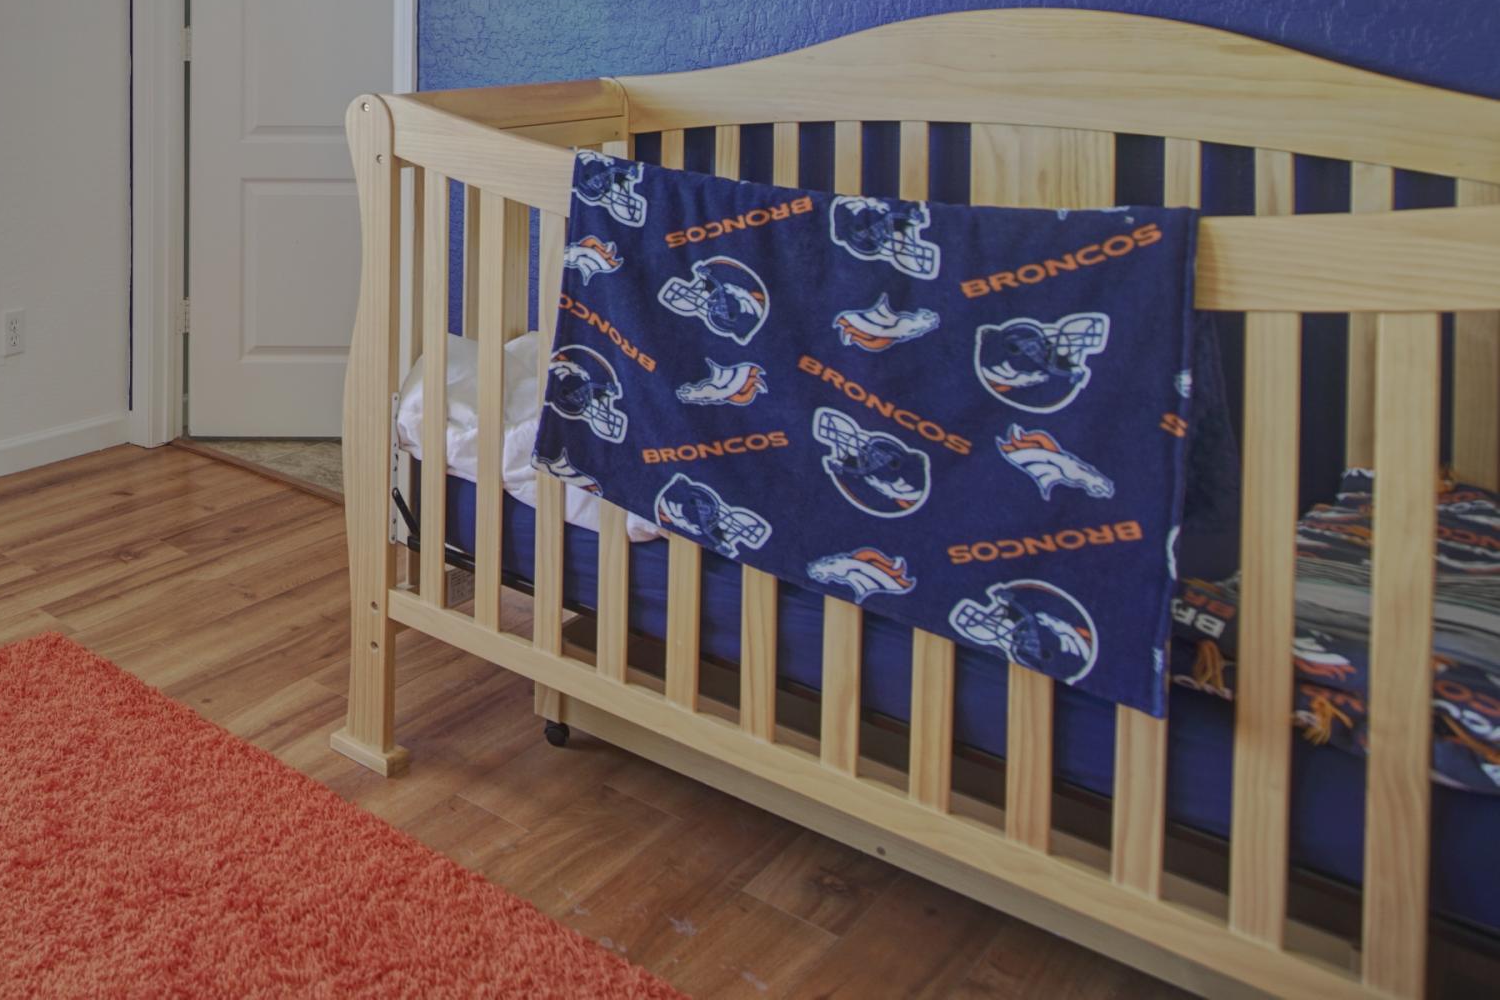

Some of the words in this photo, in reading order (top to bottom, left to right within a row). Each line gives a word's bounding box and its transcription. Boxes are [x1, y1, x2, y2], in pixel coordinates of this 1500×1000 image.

[665, 196, 813, 248] BRONCOS
[960, 224, 1162, 298] BRONCOS
[799, 355, 971, 455] BRONCOS
[642, 431, 789, 463] BRONCOS
[947, 520, 1142, 564] BRONCOS
